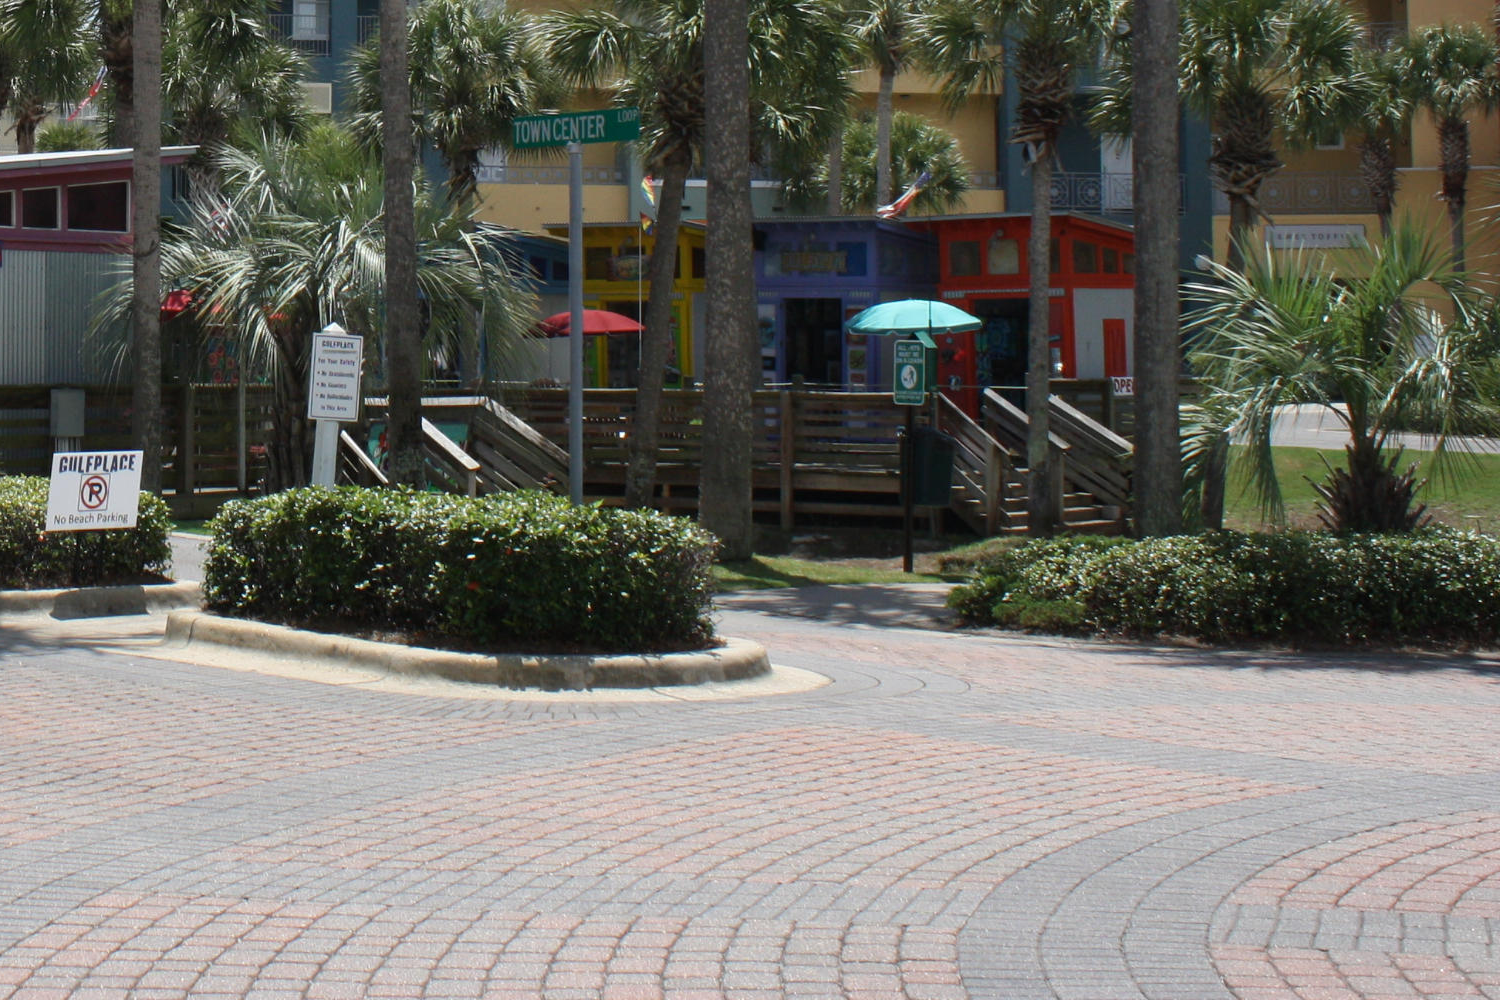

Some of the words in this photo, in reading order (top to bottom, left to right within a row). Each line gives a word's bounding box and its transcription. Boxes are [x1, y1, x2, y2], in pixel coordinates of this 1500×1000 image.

[514, 119, 550, 144] TOWN
[553, 115, 605, 140] CENTER
[618, 109, 638, 123] LOOP
[1114, 378, 1133, 392] OPE
[59, 454, 136, 473] GULFPLACE
[54, 515, 66, 525] No
[68, 513, 95, 525] Beach
[97, 512, 129, 524] Parking
